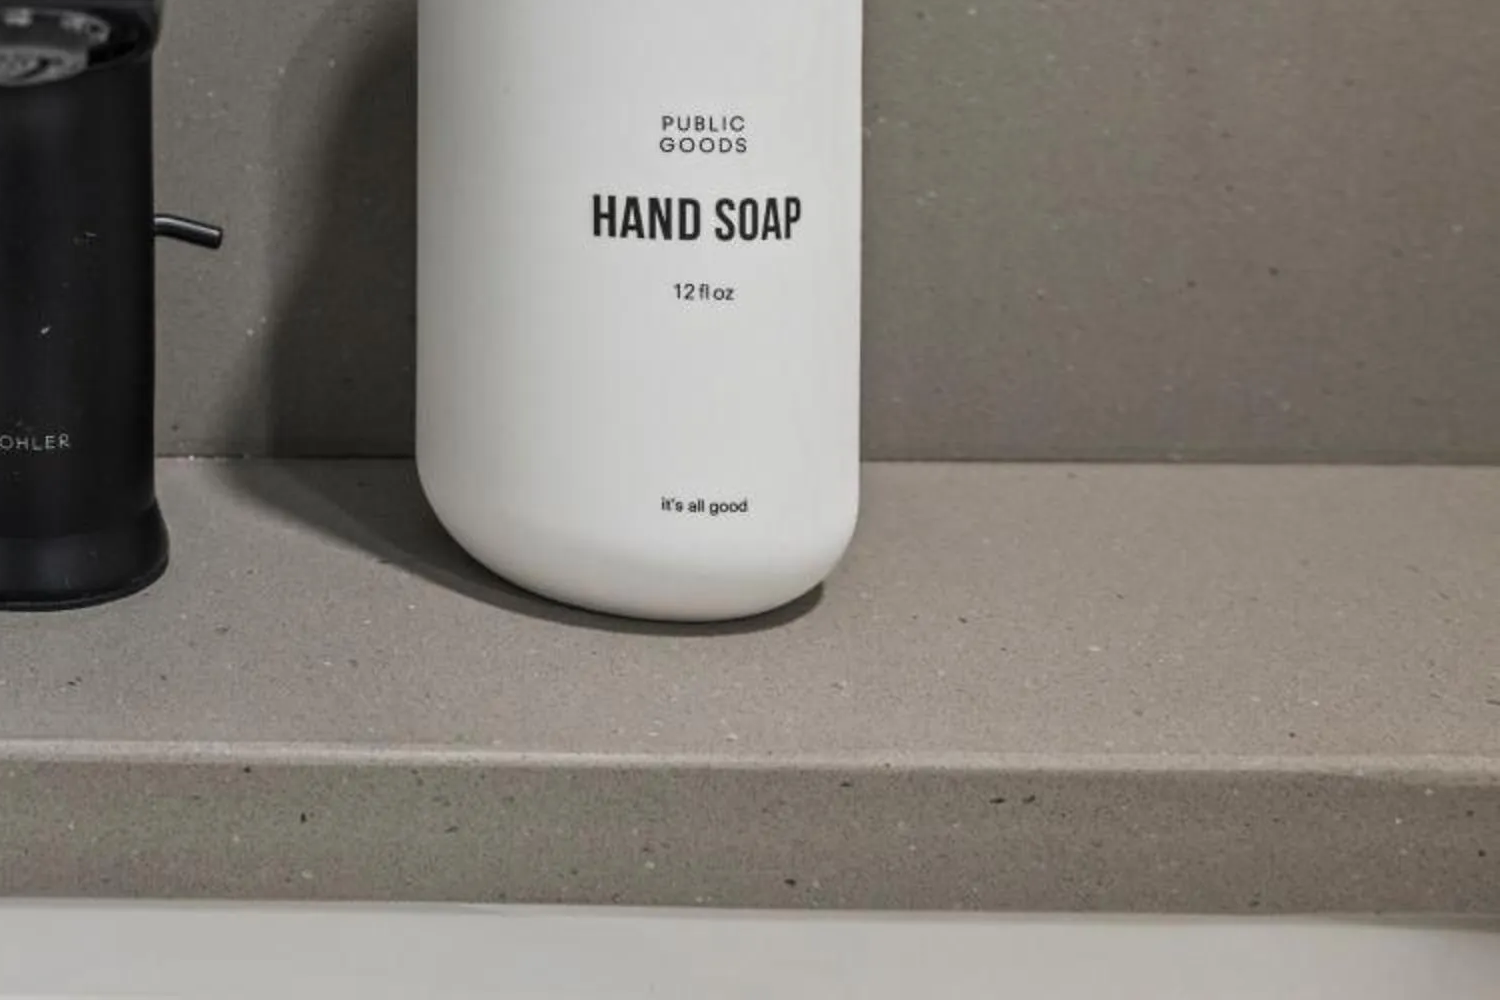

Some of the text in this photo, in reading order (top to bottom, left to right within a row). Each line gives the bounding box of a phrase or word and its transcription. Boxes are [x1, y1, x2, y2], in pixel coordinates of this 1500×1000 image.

[661, 115, 745, 133] PUBLIC
[659, 136, 748, 154] GOODS
[591, 193, 802, 243] HAND SOAP
[673, 282, 696, 301] 12
[661, 496, 749, 517] it's all good
